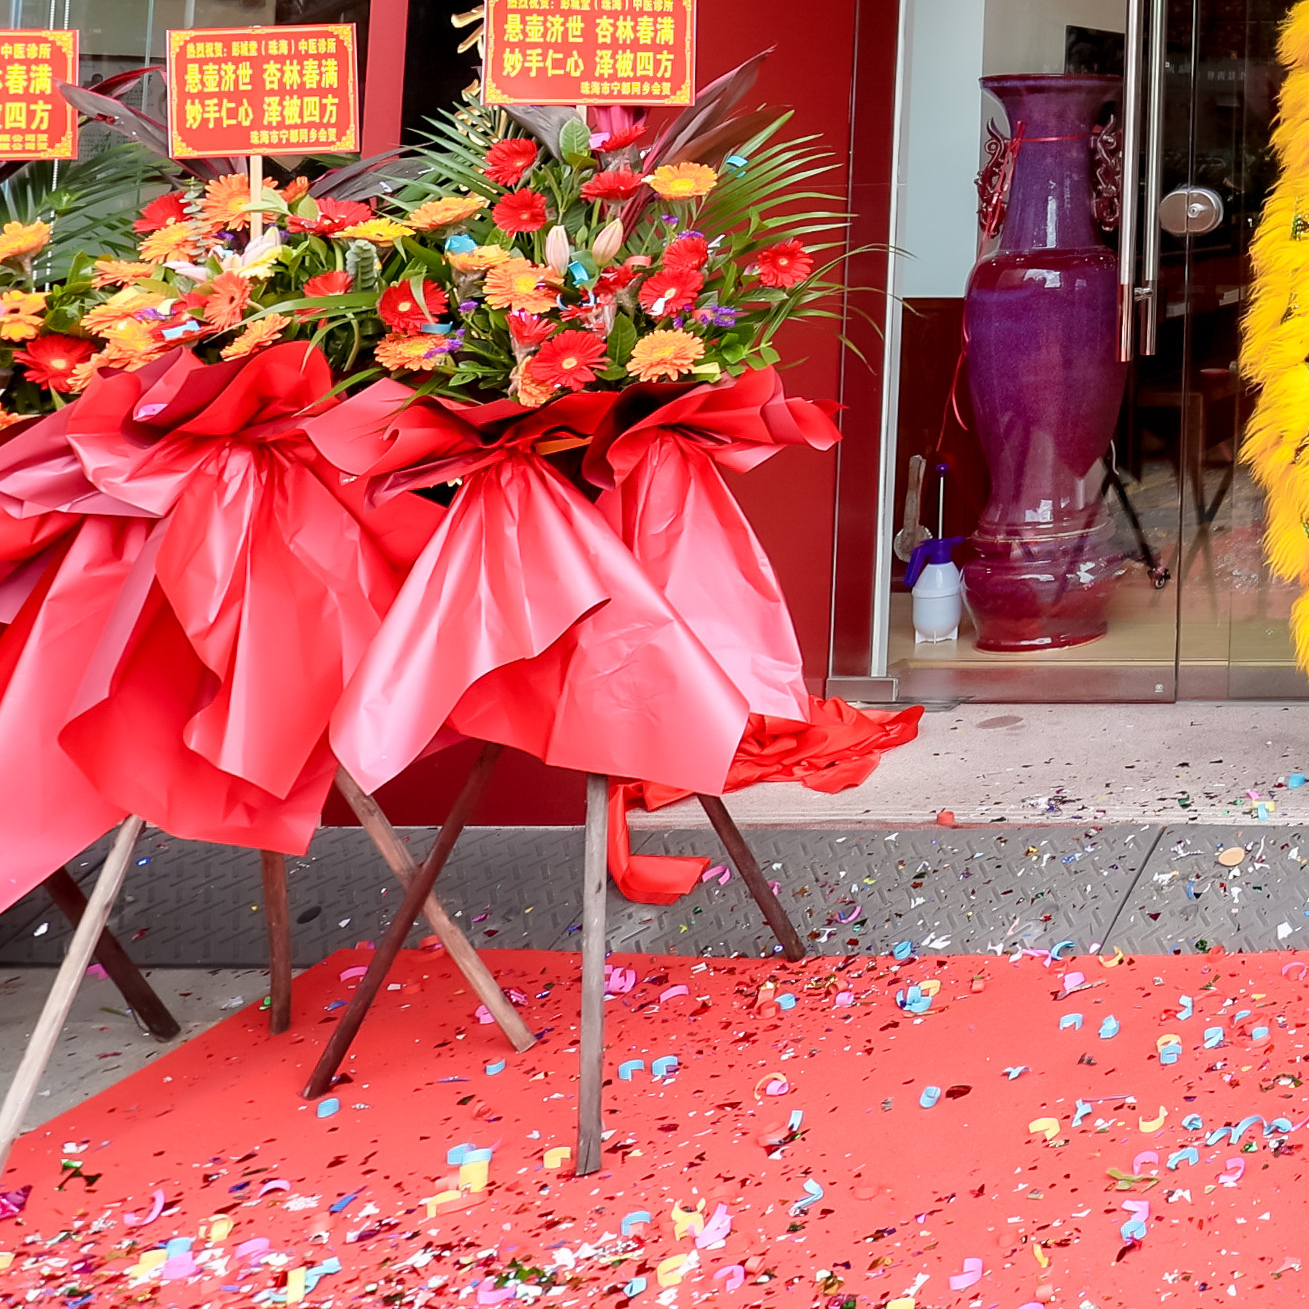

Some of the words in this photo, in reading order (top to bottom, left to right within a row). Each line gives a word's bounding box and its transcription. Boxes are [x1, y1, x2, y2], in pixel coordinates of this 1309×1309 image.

[503, 13, 585, 43] 悬壶济世
[595, 15, 675, 45] 杏林春满
[184, 61, 253, 93] 悬壶济世
[262, 58, 339, 91] 杏林春满
[502, 47, 585, 78] 妙手仁心
[594, 49, 675, 78] 泽被四方
[0, 63, 52, 95] 春满
[0, 100, 52, 131] 四方
[184, 98, 254, 129] 妙手仁心
[262, 94, 339, 127] 泽被四方
